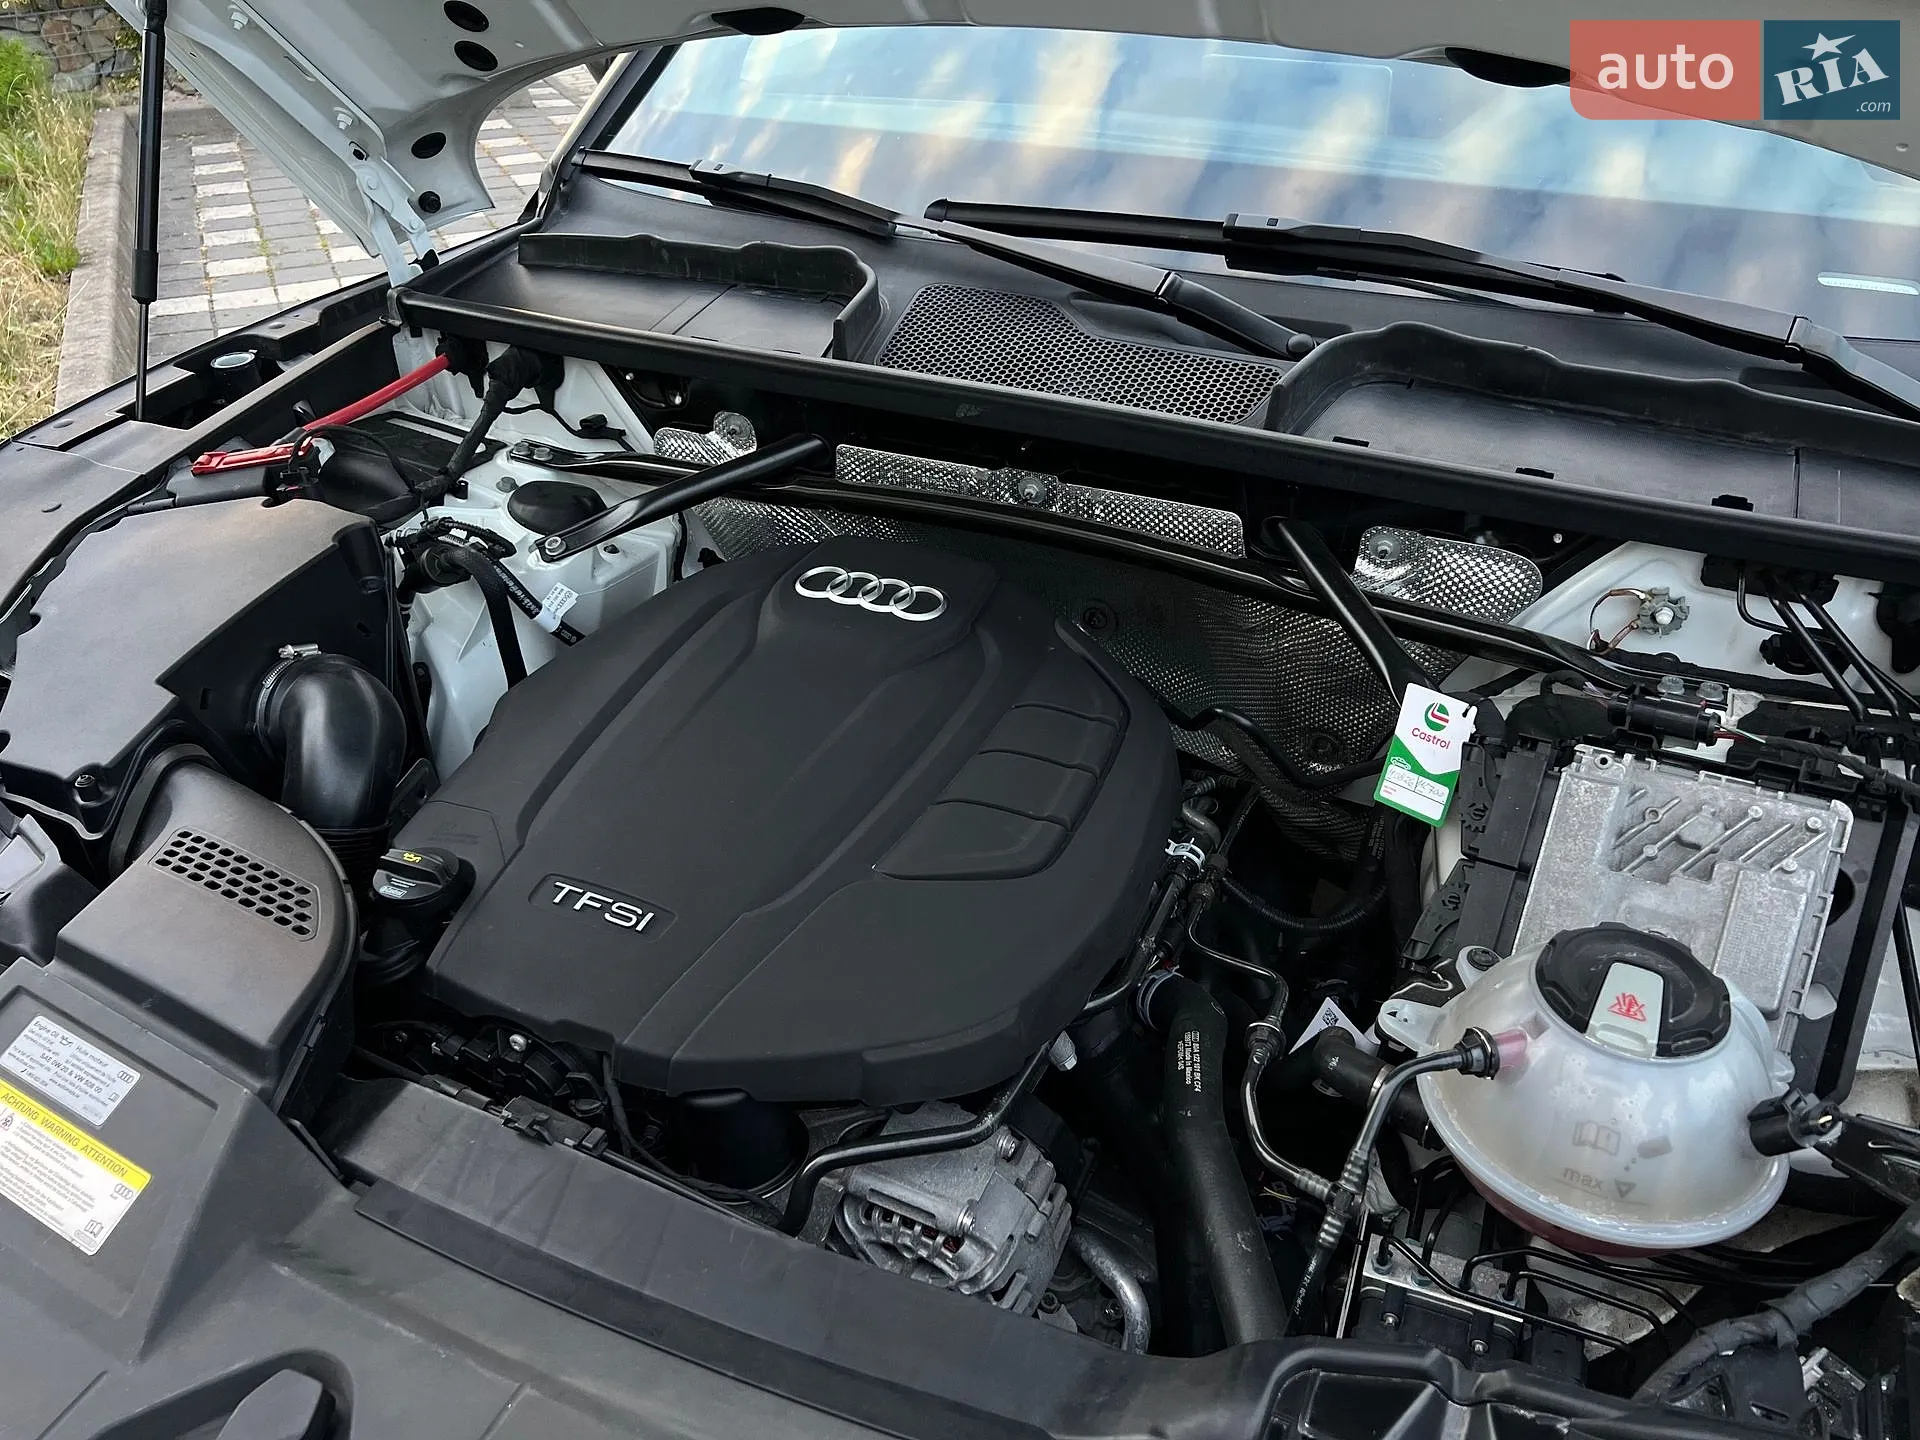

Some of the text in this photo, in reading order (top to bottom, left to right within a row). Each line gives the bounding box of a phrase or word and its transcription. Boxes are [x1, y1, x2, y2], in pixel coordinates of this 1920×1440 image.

[1411, 727, 1451, 749] Castrol
[552, 880, 655, 932] TFSI
[2, 1093, 39, 1121] ACHTUNG
[40, 1116, 80, 1147] WARNING
[80, 1143, 128, 1177] ATTENTION
[1563, 1167, 1604, 1191] max
